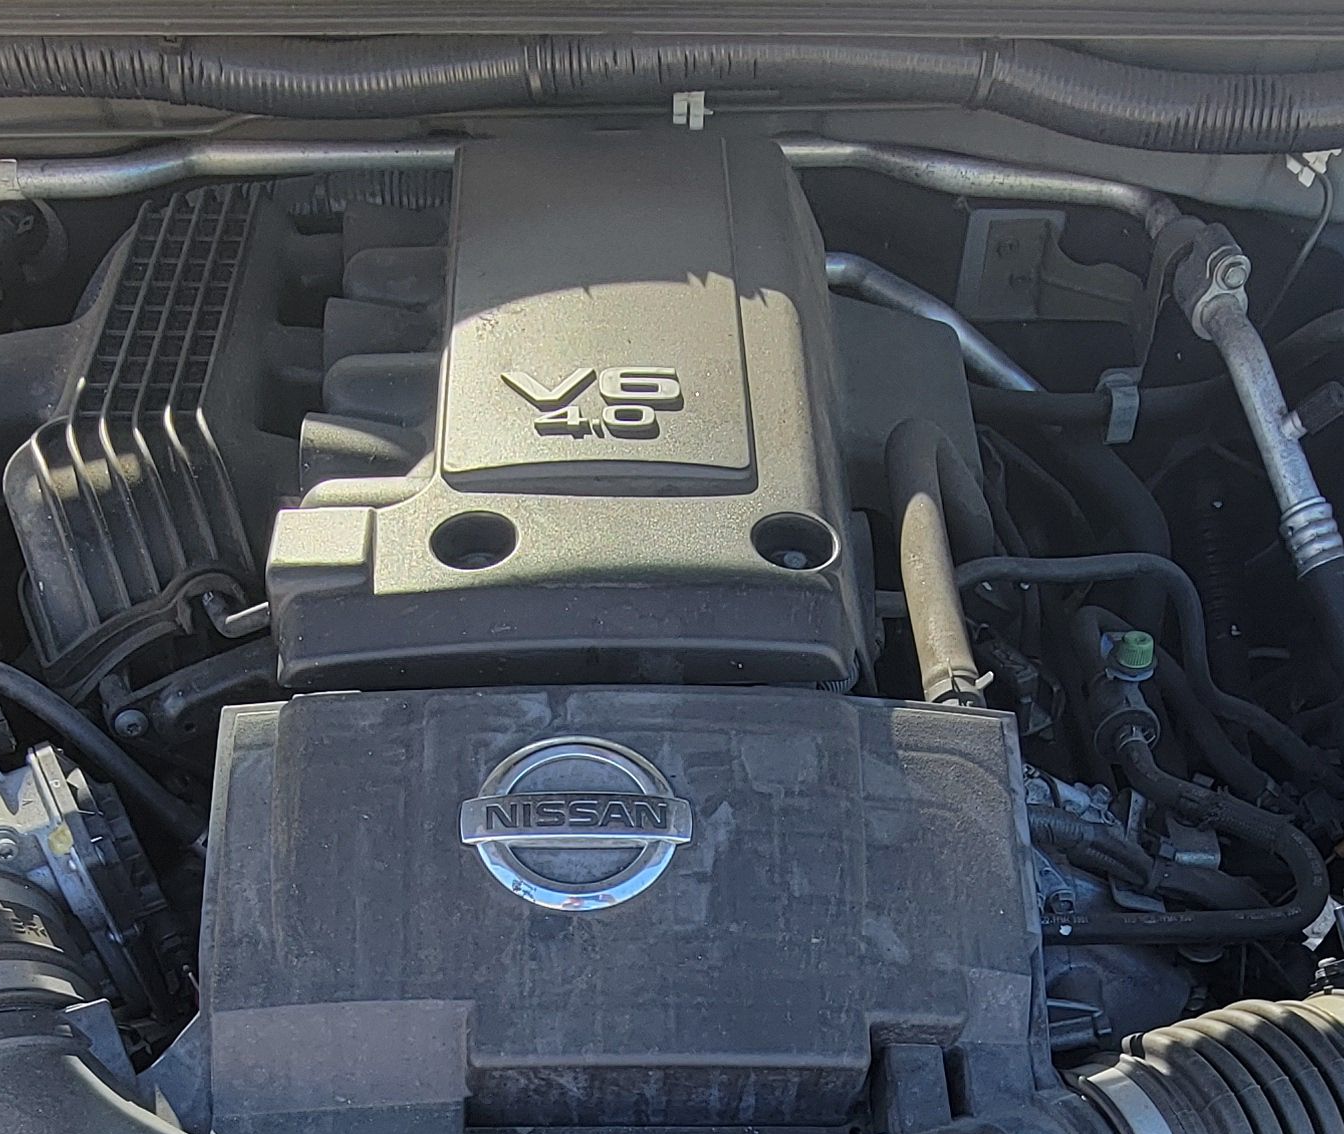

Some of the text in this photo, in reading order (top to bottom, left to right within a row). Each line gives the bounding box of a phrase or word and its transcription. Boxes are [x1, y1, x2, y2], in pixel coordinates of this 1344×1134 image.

[501, 366, 683, 411] V6
[533, 405, 660, 441] 4.0
[485, 801, 668, 831] NISSAN
